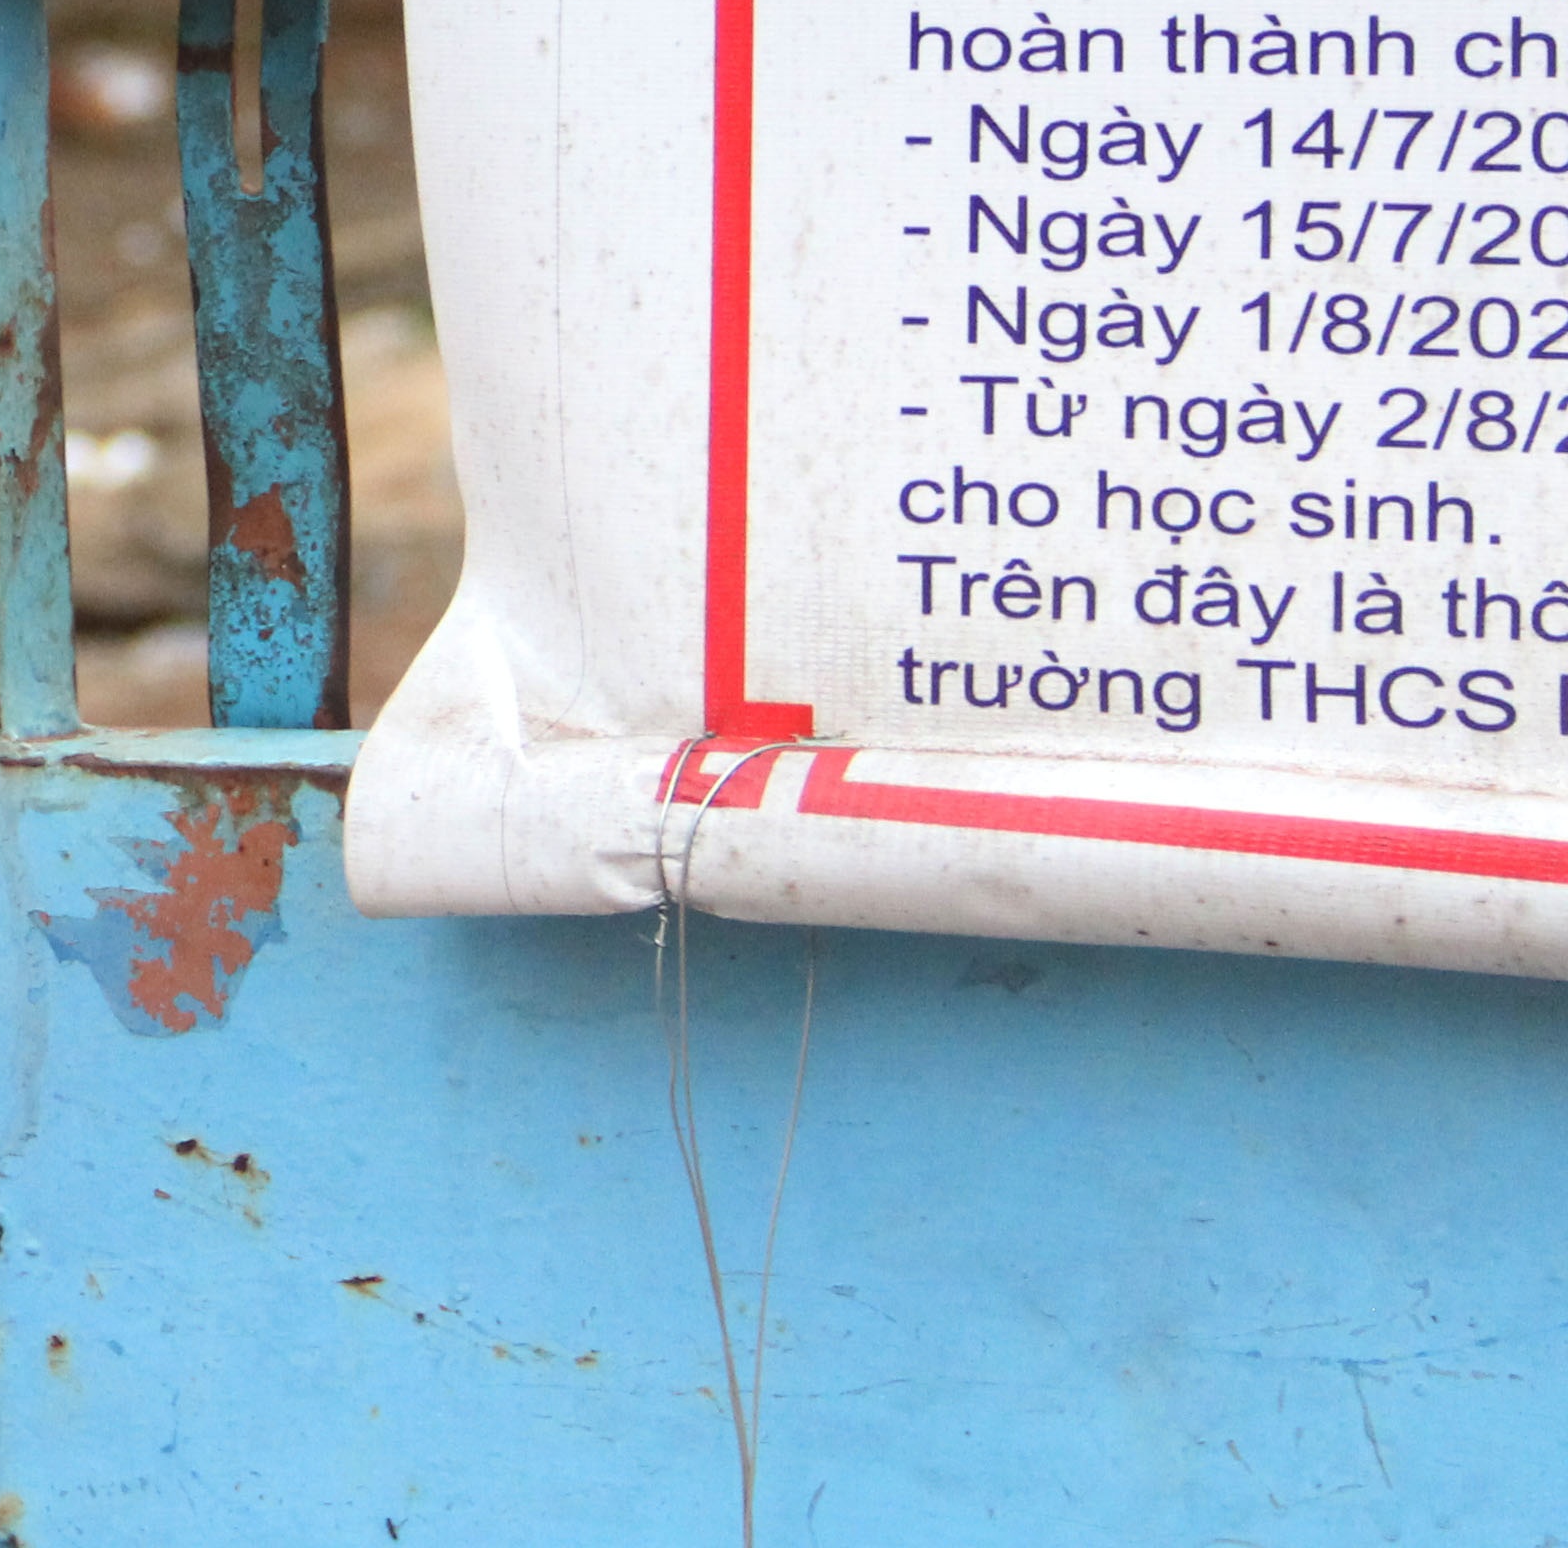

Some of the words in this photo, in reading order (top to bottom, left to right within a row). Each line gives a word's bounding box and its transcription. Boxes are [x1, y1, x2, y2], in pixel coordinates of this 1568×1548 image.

[909, 11, 1124, 73] hoàn
[1161, 13, 1415, 76] thành
[1455, 16, 1557, 79] ch
[970, 104, 1203, 183] Ngày
[1244, 108, 1568, 174] 14/7/20
[968, 194, 1202, 275] Ngày
[1243, 200, 1568, 268] 15/7/20
[967, 285, 1201, 366] Ngày
[1241, 291, 1568, 360] 1/8/202
[959, 375, 1087, 437] Từ
[1125, 383, 1342, 462] ngày
[1376, 387, 1568, 454] 2/8/
[899, 465, 1059, 528] cho
[1097, 469, 1255, 545] học
[1289, 478, 1501, 545] sinh.
[897, 555, 1096, 622] Trên
[1134, 564, 1297, 646] đây
[1333, 571, 1404, 635] là
[897, 647, 1201, 733] trường
[1236, 659, 1517, 733] THCS
